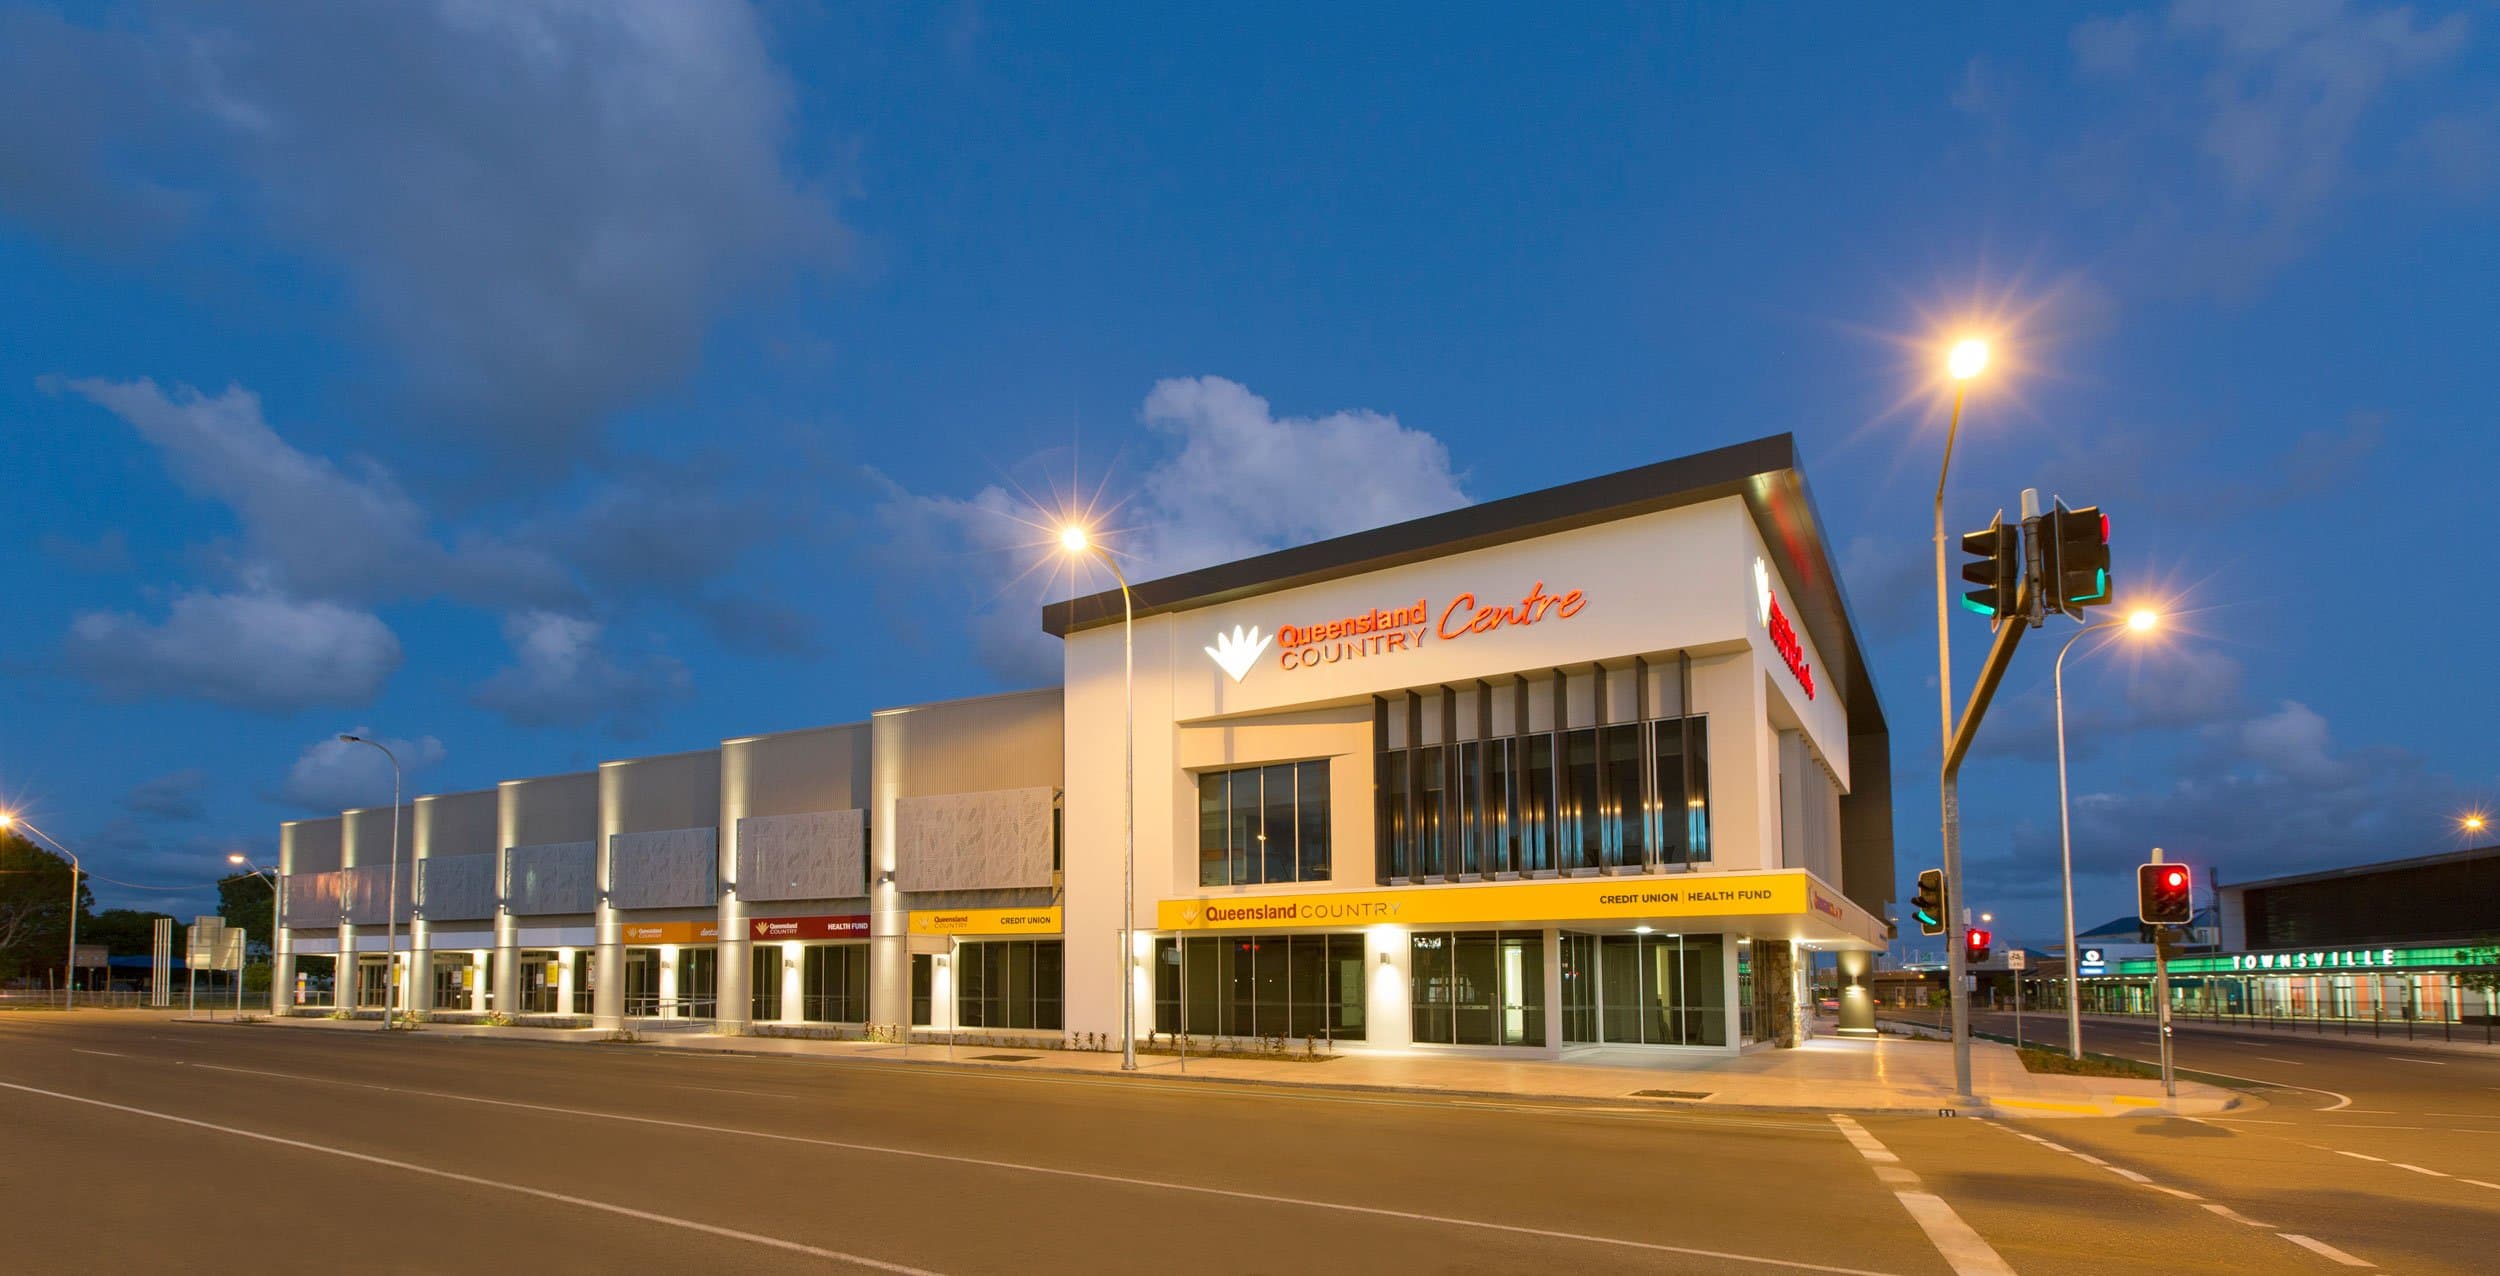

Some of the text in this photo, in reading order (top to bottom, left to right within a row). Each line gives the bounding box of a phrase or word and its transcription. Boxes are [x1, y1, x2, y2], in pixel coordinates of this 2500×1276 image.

[1437, 580, 1586, 641] Centre
[1278, 600, 1427, 648] Queensland
[1280, 626, 1427, 671] COUNTRY
[1600, 889, 1772, 904] CREDIT UNION HEALTH FUND
[1027, 916, 1050, 924] UNION
[1206, 902, 1400, 922] Queensland COUNTRY
[828, 922, 869, 931] HEALTH FUND
[2232, 950, 2394, 970] TOWNSVILLE
